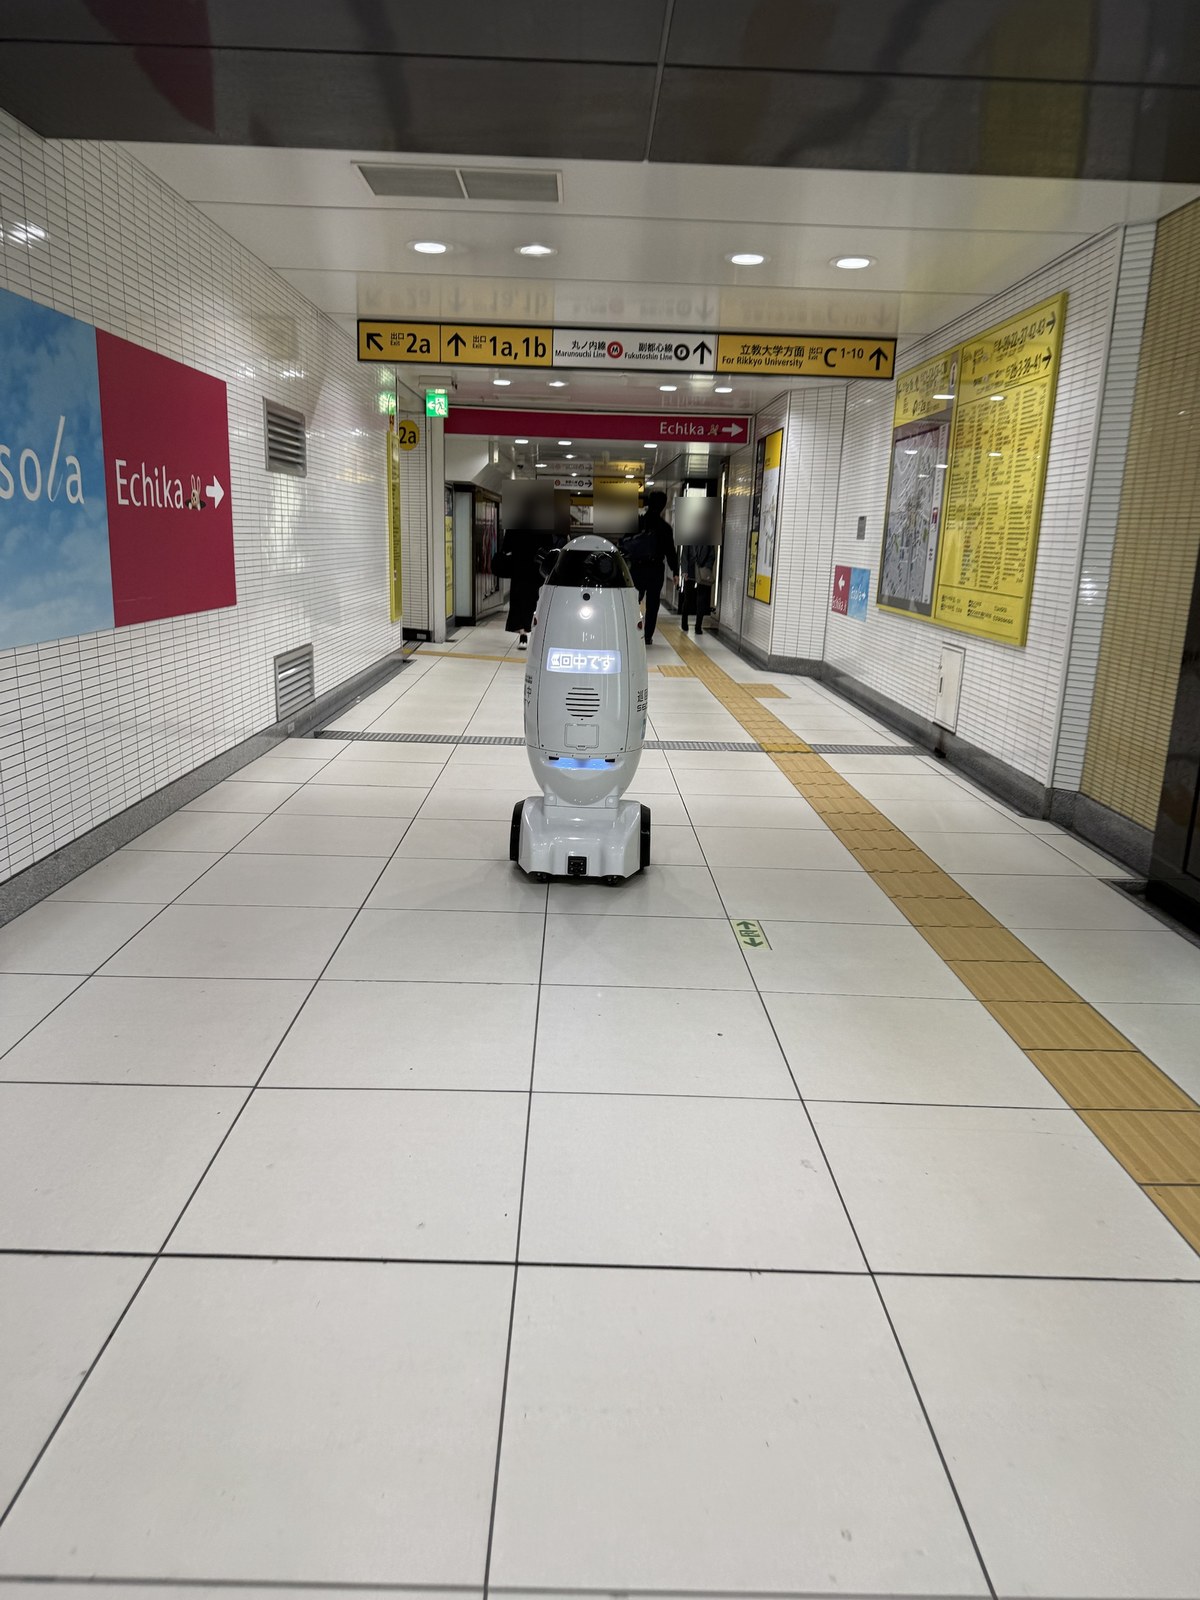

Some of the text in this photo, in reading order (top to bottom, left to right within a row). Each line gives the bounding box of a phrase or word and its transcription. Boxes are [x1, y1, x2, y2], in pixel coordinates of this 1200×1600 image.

[406, 332, 431, 354] 2a
[571, 340, 606, 351] 丸ノ内線
[555, 349, 606, 358] Marunouchi Line
[740, 344, 805, 358] 立教大学方面
[824, 347, 864, 368] C 1-10
[722, 355, 804, 369] For Rikkyo University
[399, 426, 417, 444] 2a
[660, 421, 704, 436] Echika
[115, 458, 184, 509] Echika
